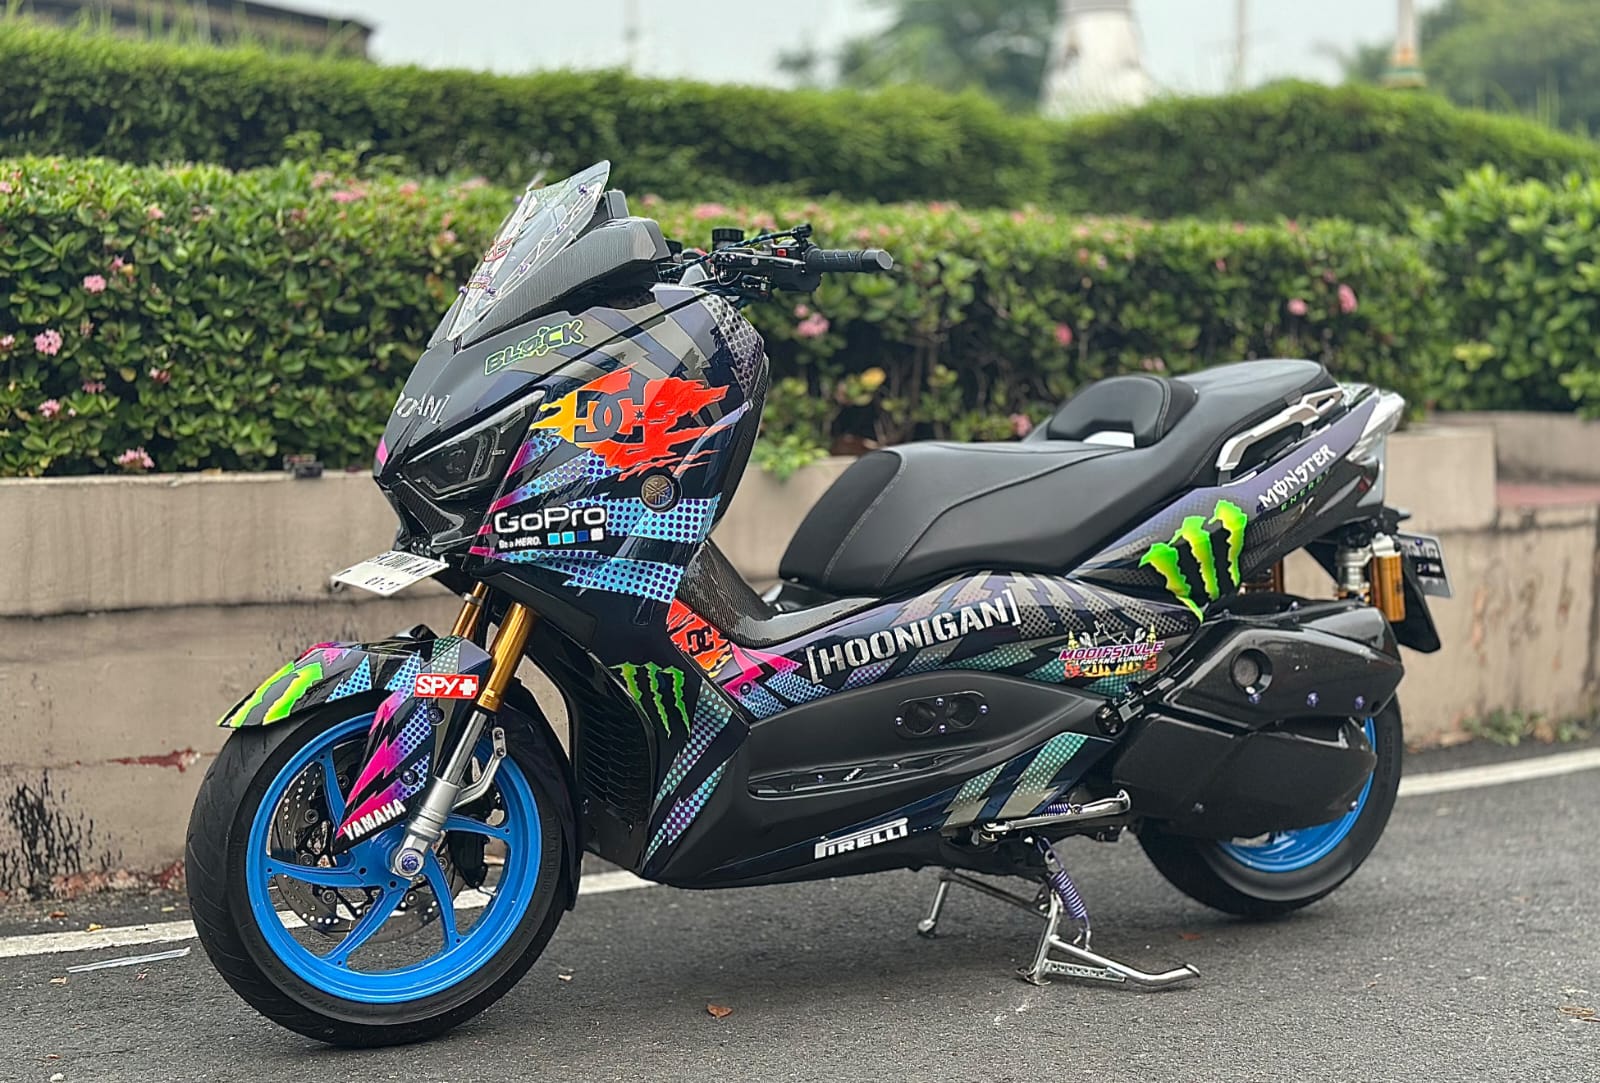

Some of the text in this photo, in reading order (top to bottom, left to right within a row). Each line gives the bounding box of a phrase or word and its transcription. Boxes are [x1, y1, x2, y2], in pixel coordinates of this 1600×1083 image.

[574, 387, 645, 444] DC
[494, 506, 606, 533] GoPro
[803, 588, 1022, 685] [HOONIGAN]
[342, 798, 407, 841] YAMAHA
[814, 817, 908, 859] PIRELLI
